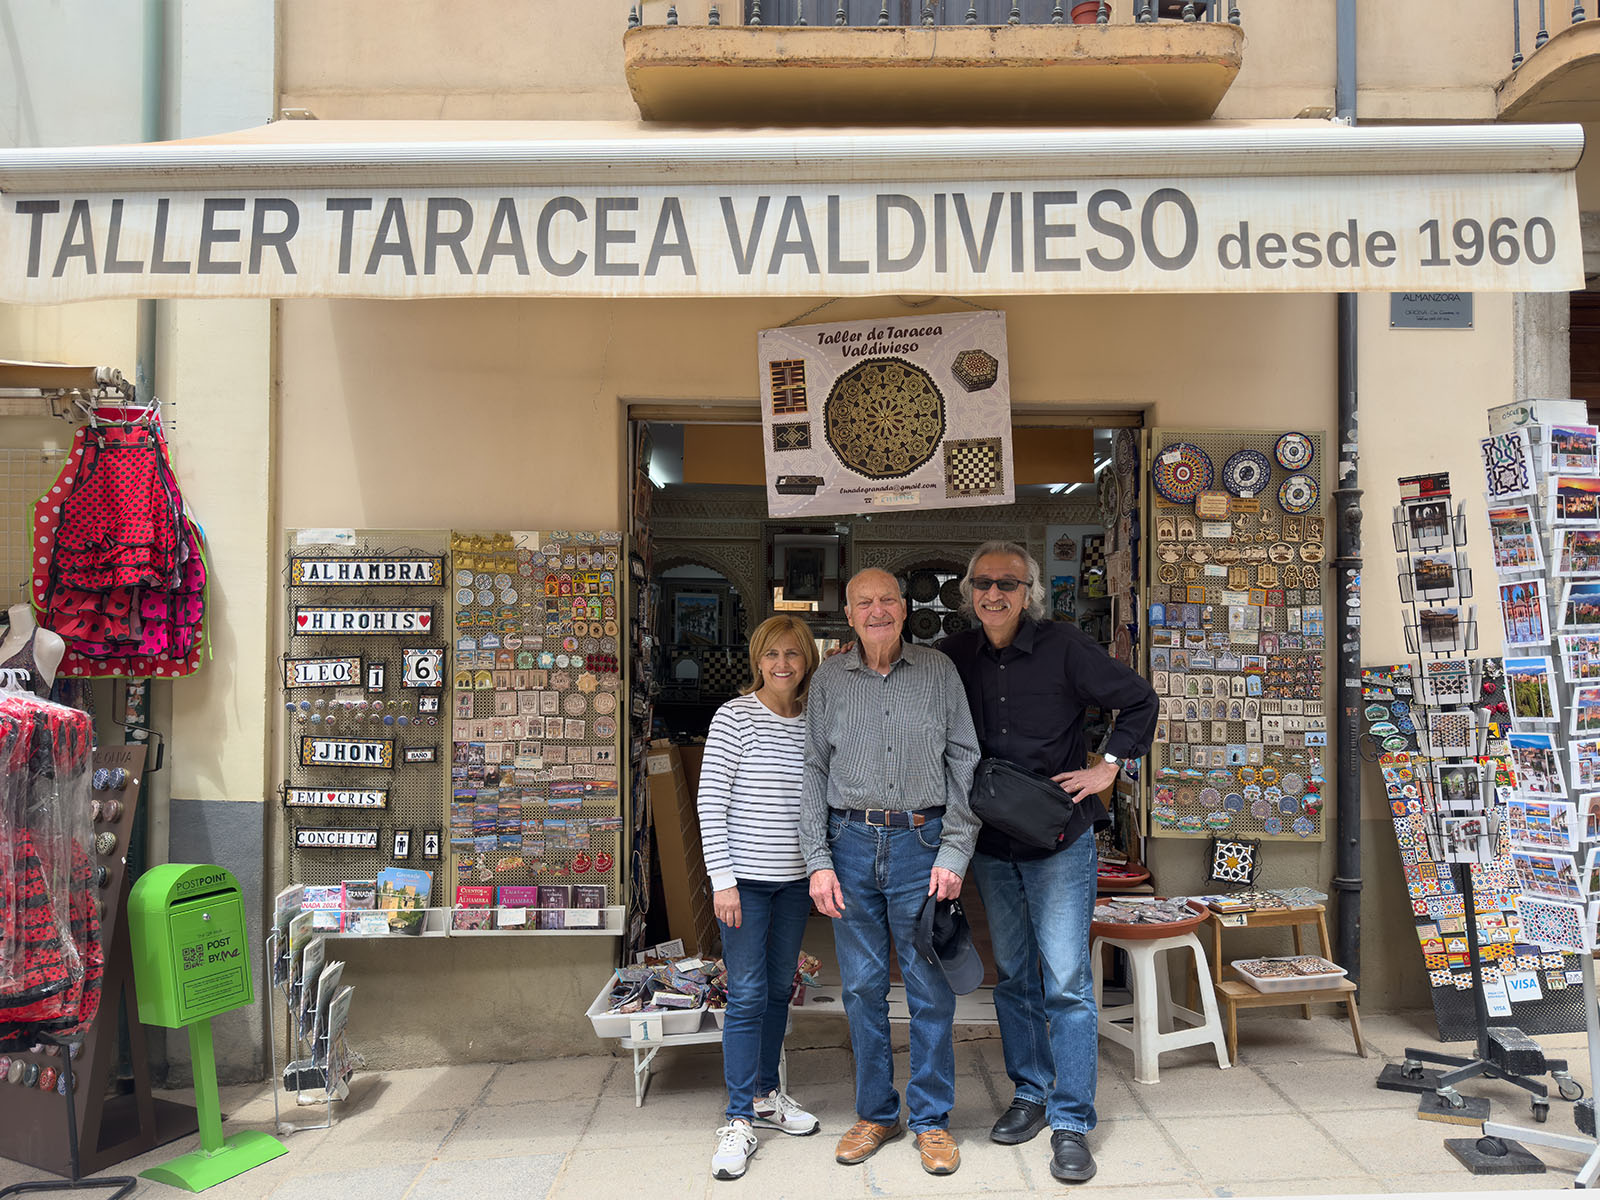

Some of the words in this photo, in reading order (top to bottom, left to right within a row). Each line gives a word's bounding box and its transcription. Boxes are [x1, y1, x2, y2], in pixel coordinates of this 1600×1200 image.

[15, 197, 301, 278] TALLER
[326, 195, 697, 277] TARACEA
[719, 187, 1200, 275] VALDIVIESO
[1216, 218, 1398, 270] desde
[1418, 215, 1557, 267] 1960
[1402, 293, 1462, 302] ALMANZORA
[817, 328, 863, 346] Taller
[867, 327, 885, 342] de
[887, 324, 943, 339] Taracea
[841, 340, 920, 358] Valdivieso
[514, 534, 529, 549] 2
[308, 563, 427, 582] ALHAMBRA
[312, 612, 416, 631] HIROHIS
[303, 664, 346, 682] LEO
[415, 657, 431, 680] 6
[373, 671, 380, 686] 1
[318, 742, 378, 762] JHON
[297, 791, 324, 804] EMI
[337, 792, 376, 806] CRIS
[297, 832, 377, 845] CONCHITA
[176, 872, 227, 891] POSTPOINT
[1235, 914, 1244, 925] 4
[207, 937, 231, 951] POST
[1510, 978, 1537, 990] VISA
[641, 1020, 651, 1042] 1
